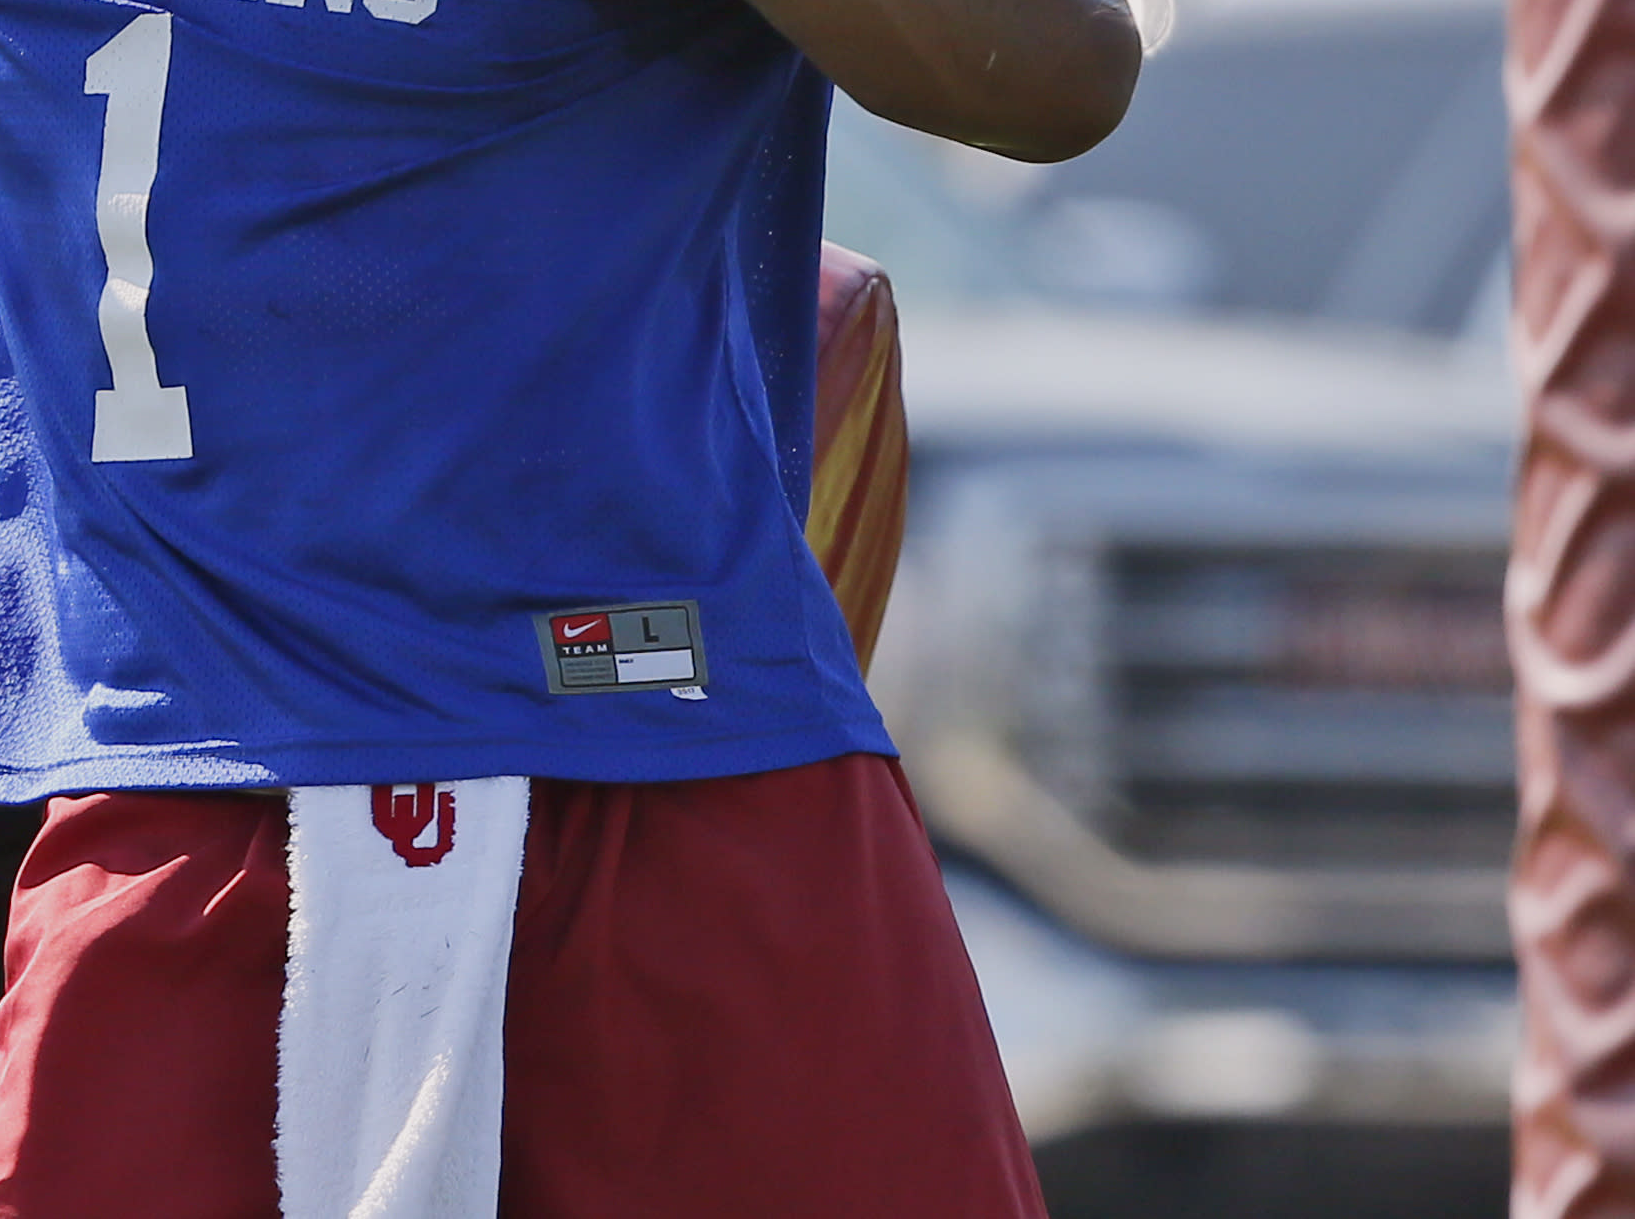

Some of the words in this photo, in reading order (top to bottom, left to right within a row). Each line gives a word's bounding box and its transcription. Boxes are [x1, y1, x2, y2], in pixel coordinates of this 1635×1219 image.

[82, 12, 194, 464] 1
[641, 616, 660, 644] L
[562, 643, 609, 656] TEAM
